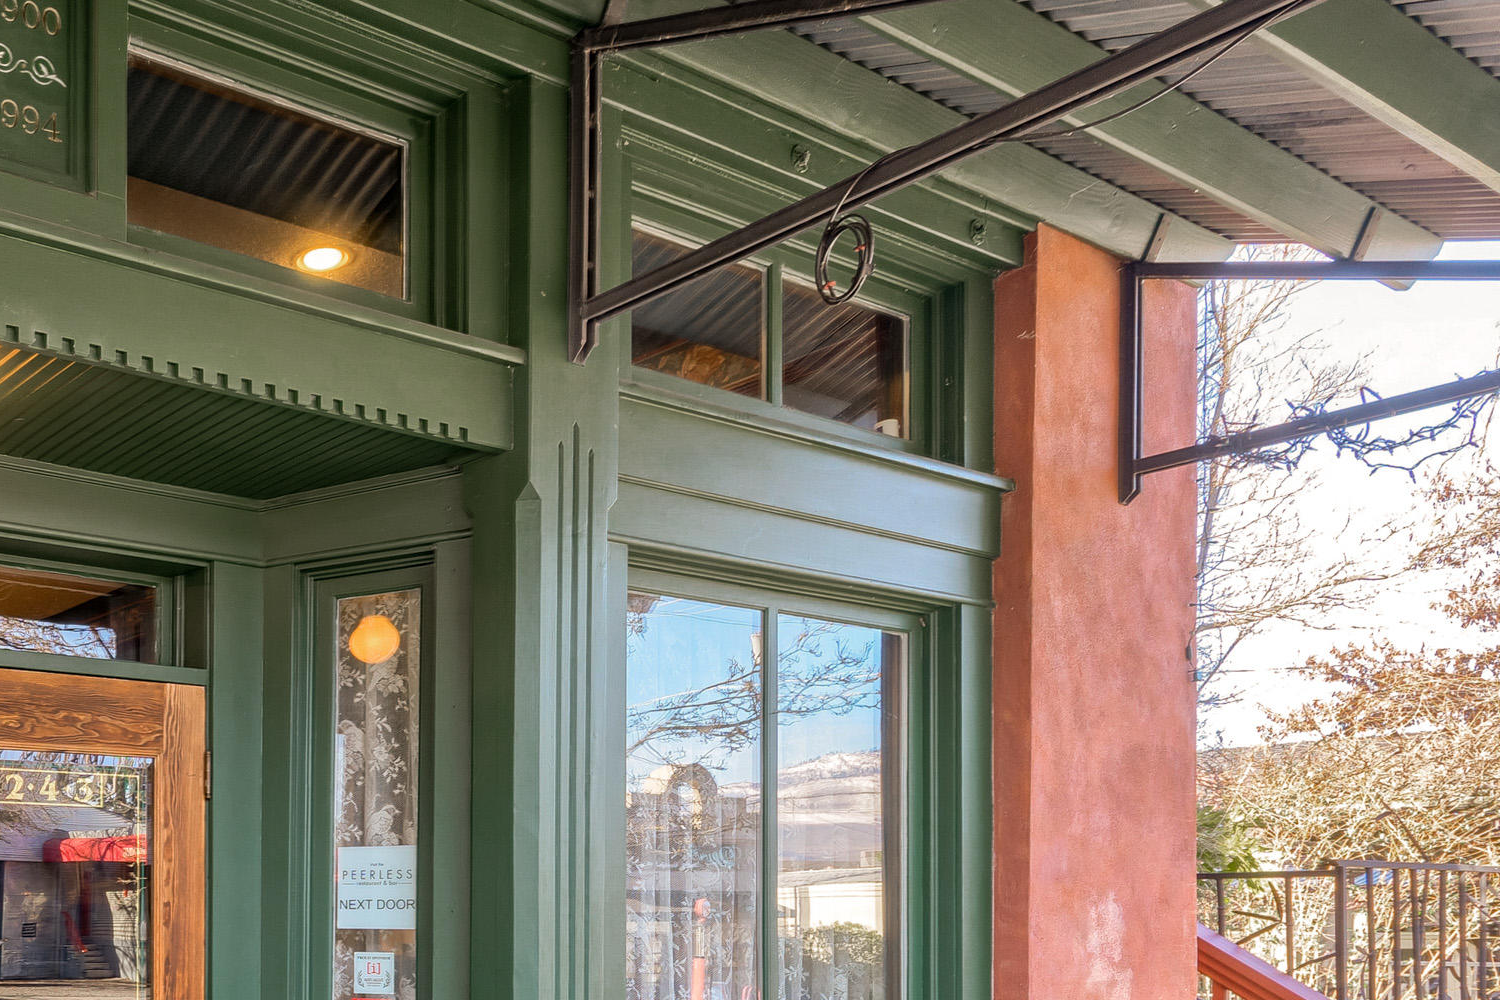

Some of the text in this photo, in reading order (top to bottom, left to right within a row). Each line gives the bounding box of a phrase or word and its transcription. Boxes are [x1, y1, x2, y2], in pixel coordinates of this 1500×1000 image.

[342, 869, 413, 880] PEERLESS
[340, 899, 415, 910] NEXT DOOR
